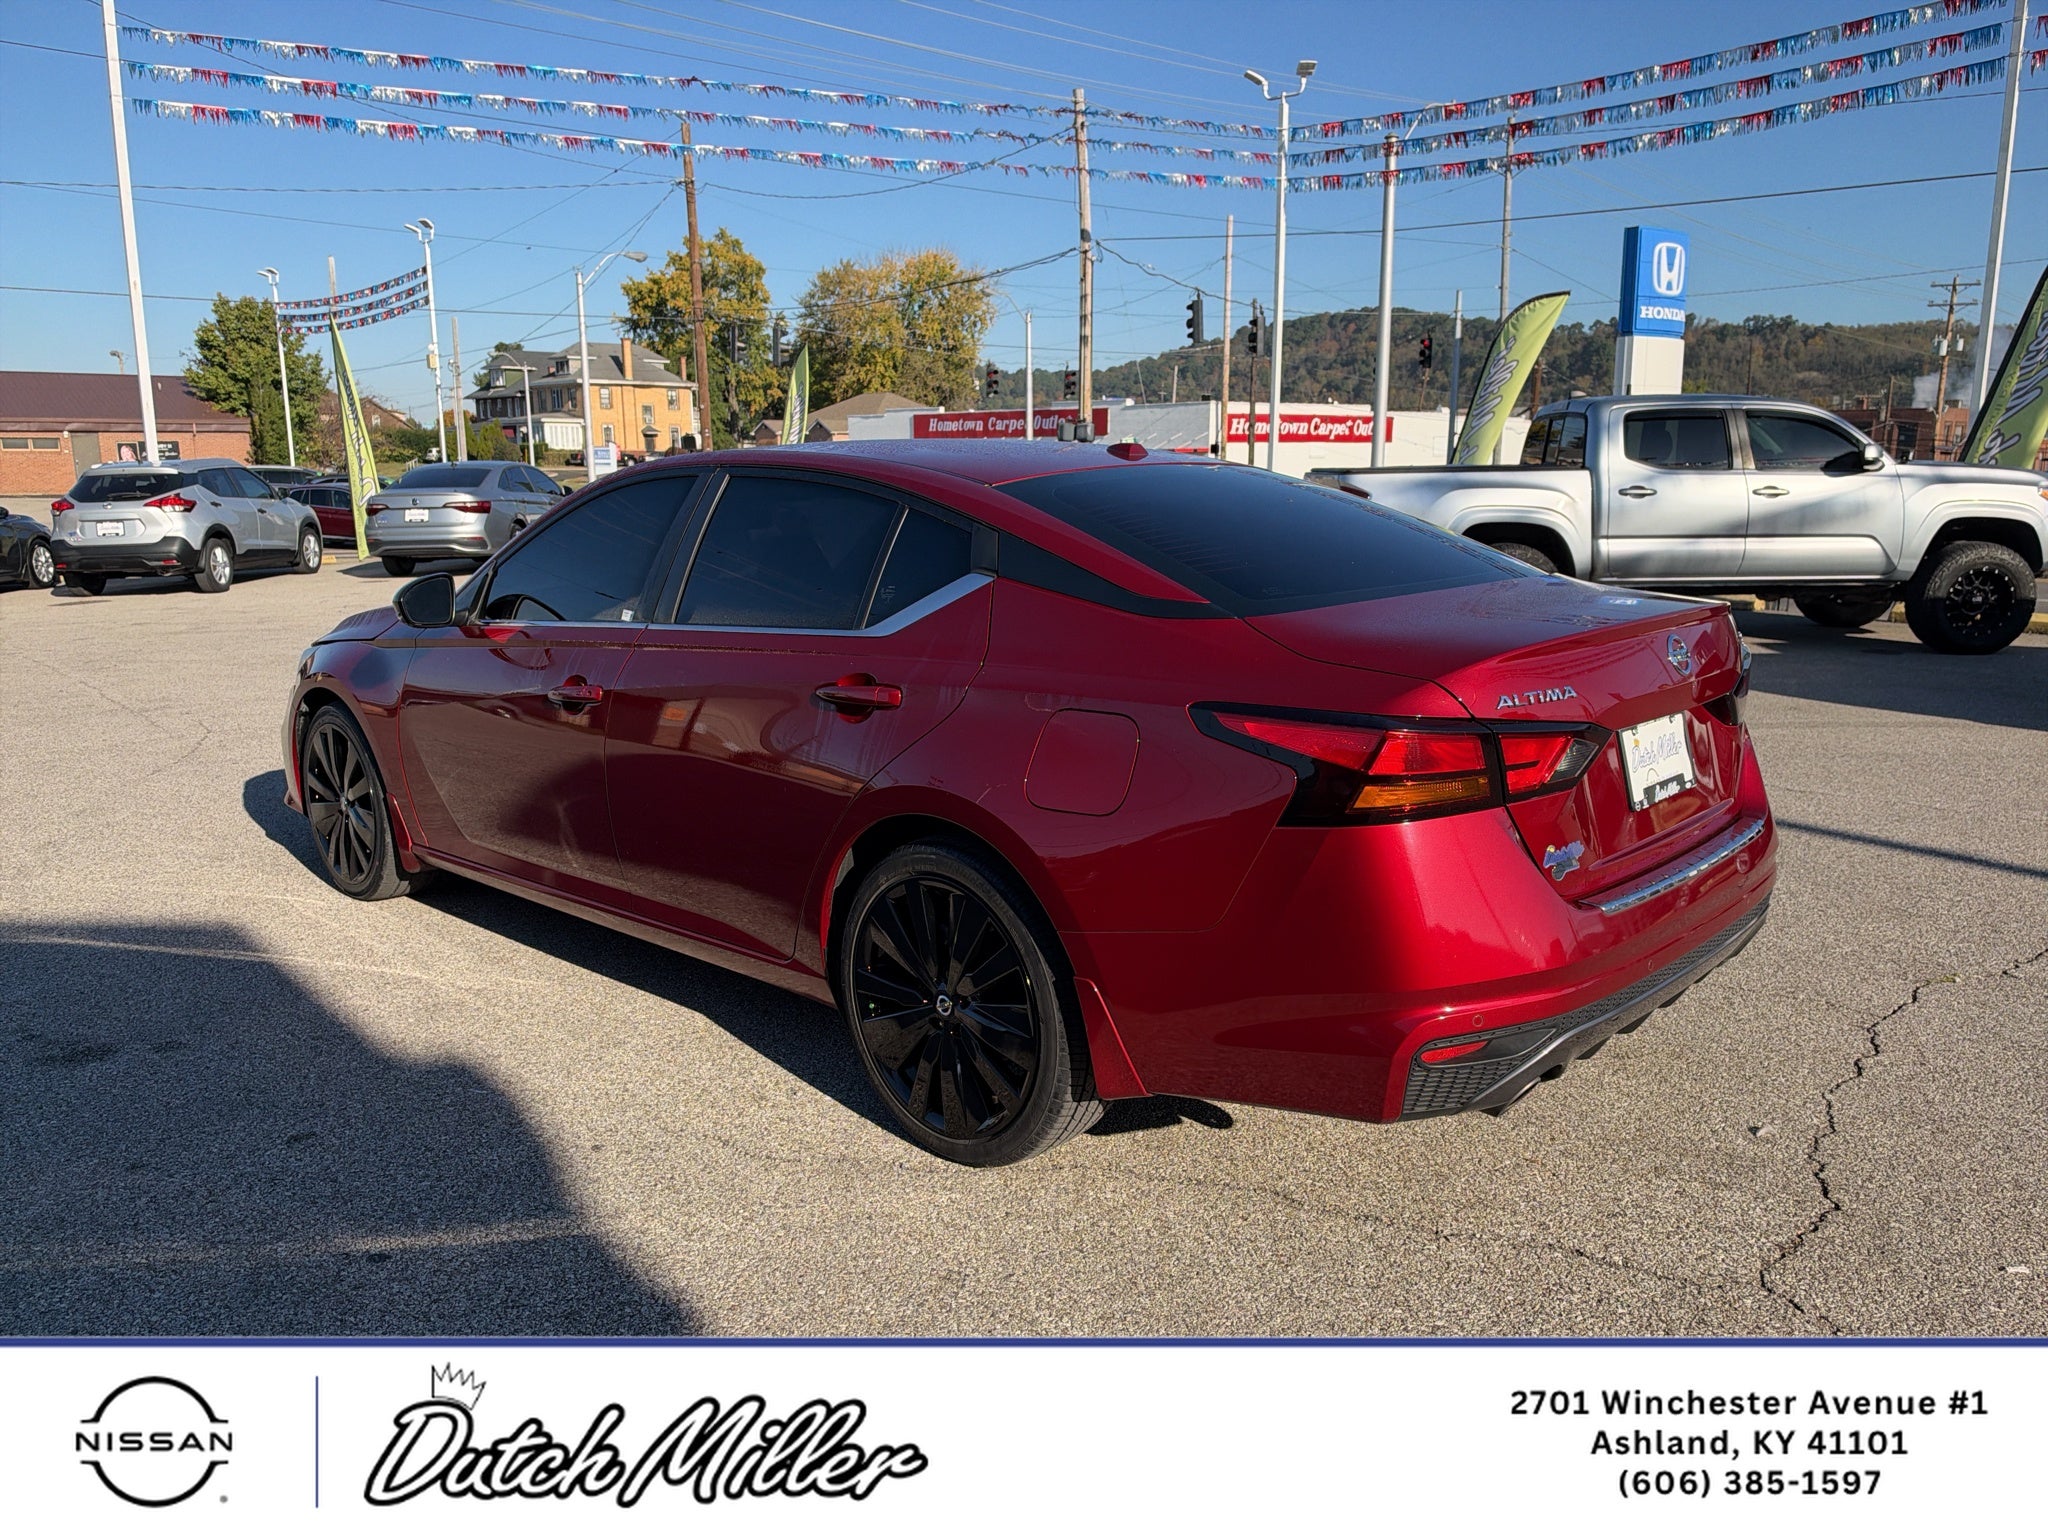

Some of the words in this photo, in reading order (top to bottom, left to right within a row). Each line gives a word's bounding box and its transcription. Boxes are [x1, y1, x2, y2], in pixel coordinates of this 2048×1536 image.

[928, 417, 984, 432] Hometown
[988, 416, 1027, 434] Carpe
[1310, 417, 1353, 439] Carpet
[1496, 685, 1578, 710] ALTIMA
